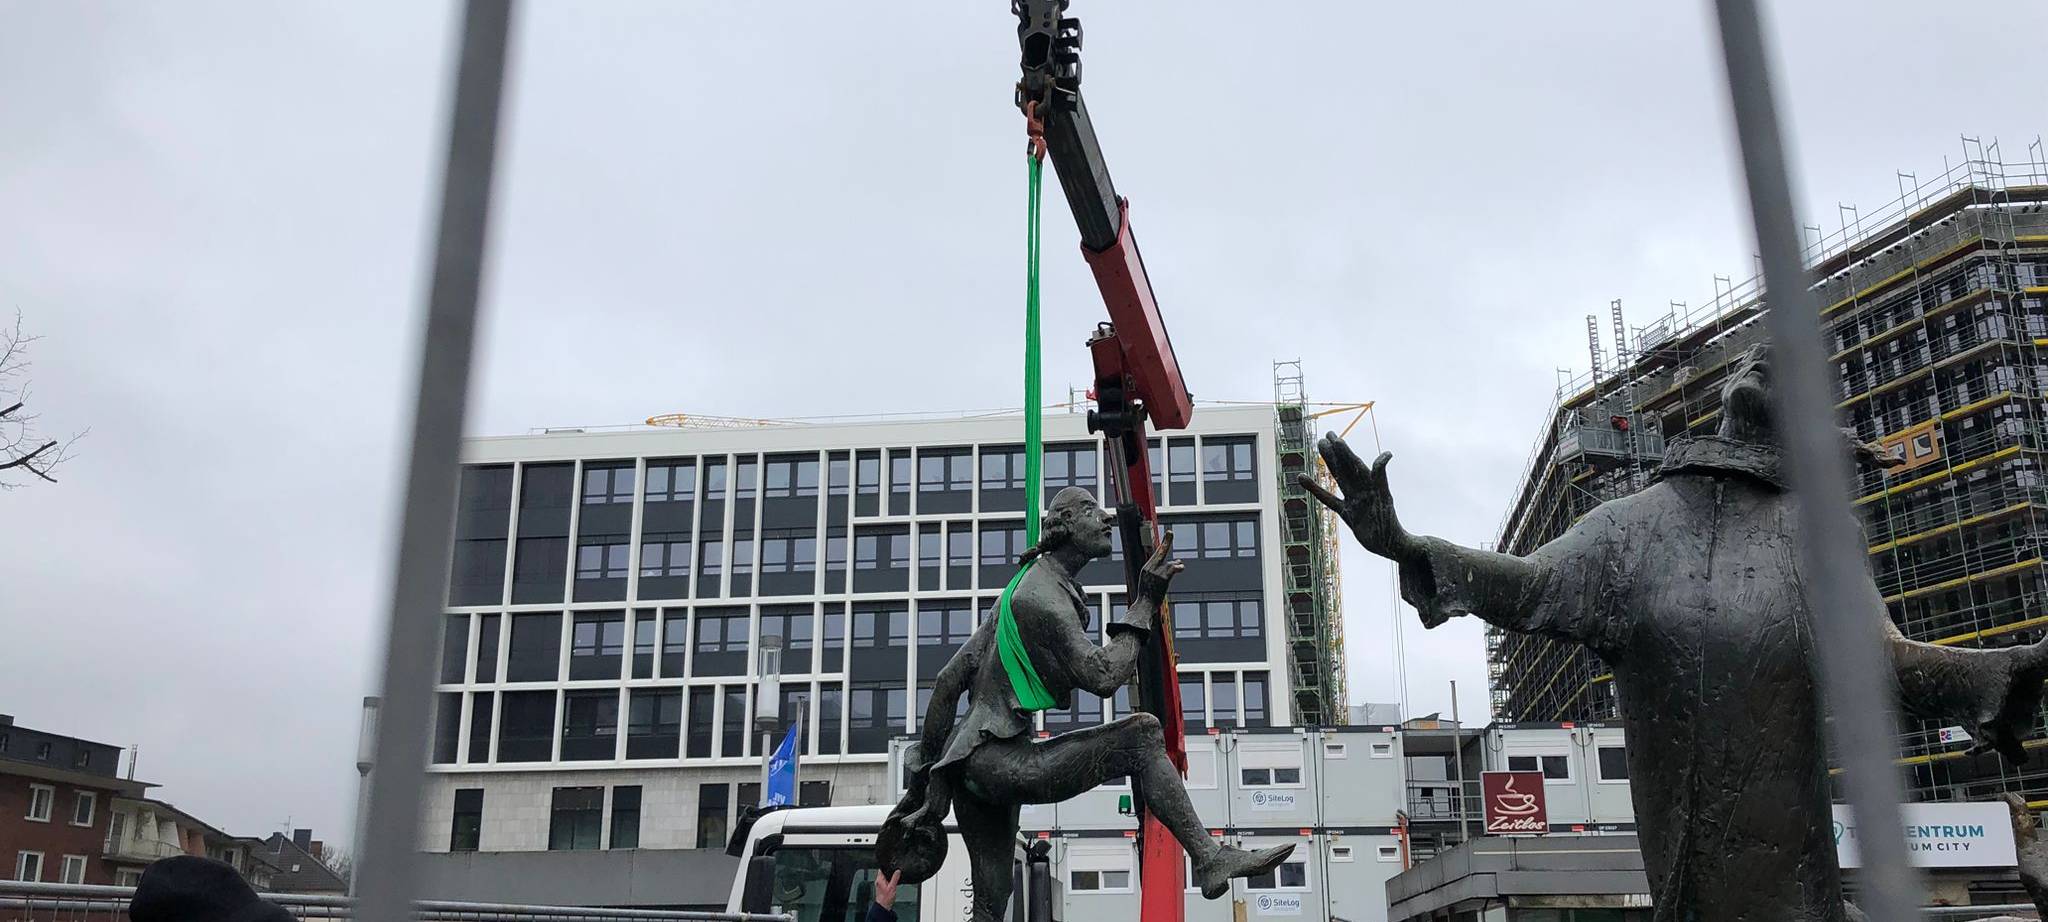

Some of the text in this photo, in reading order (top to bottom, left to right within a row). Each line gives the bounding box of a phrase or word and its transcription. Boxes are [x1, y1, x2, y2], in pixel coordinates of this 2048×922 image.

[1267, 794, 1294, 804] SiteLog
[1488, 816, 1546, 830] Zeitlos
[1937, 842, 1970, 851] CITY
[1273, 898, 1300, 908] SiteLog
